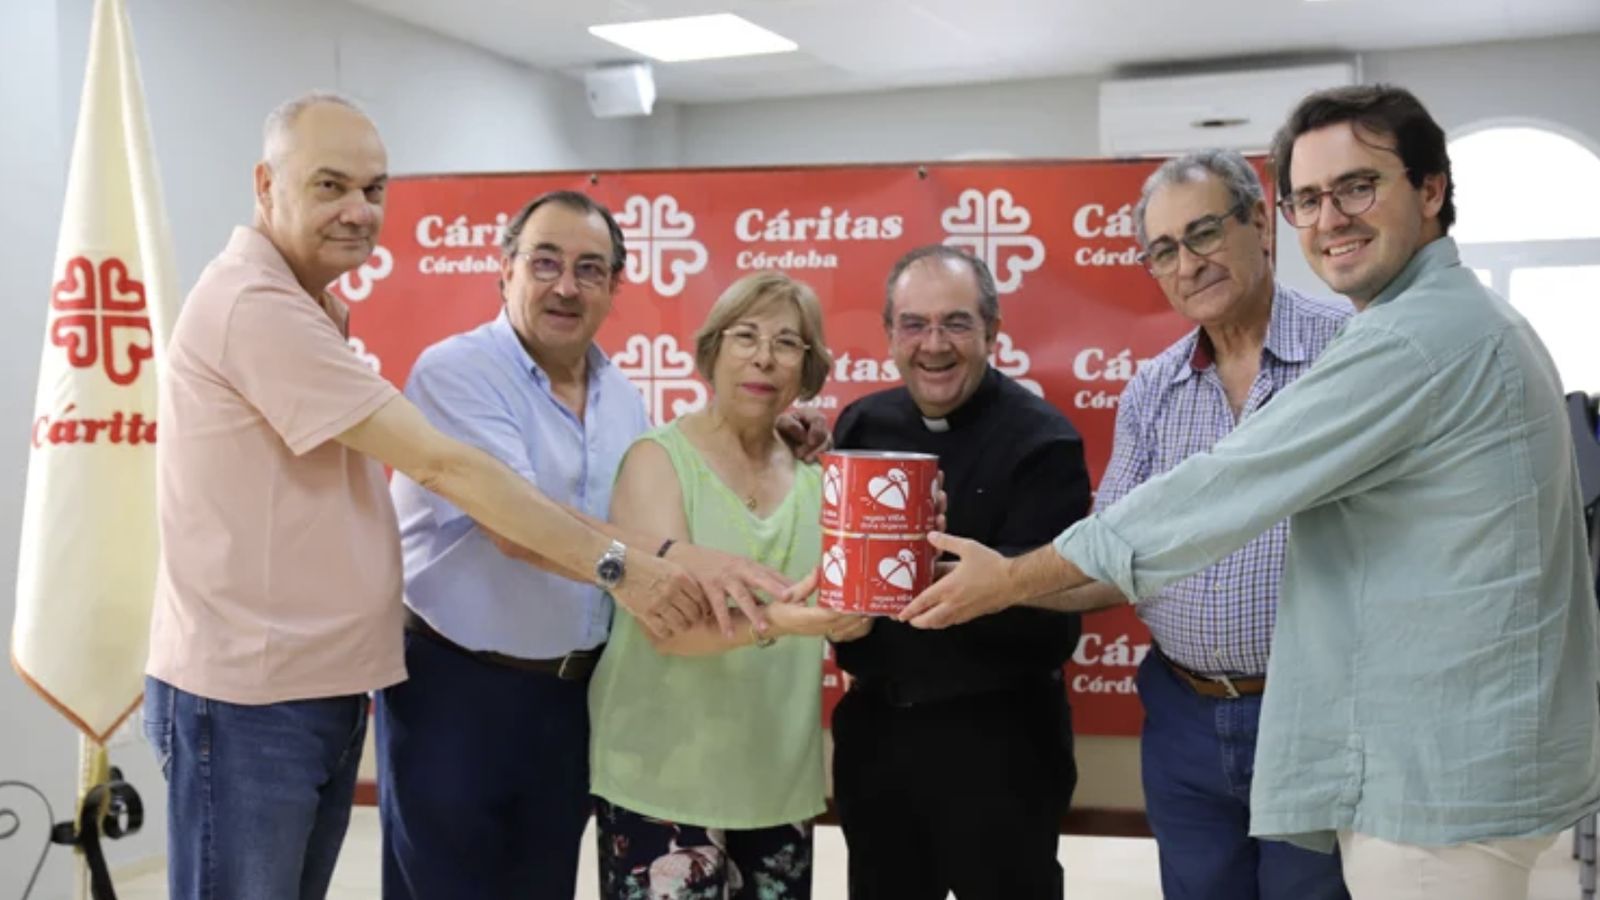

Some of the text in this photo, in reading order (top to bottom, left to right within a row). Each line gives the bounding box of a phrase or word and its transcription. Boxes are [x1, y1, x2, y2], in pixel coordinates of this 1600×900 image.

[416, 213, 508, 248] Cári
[735, 206, 903, 242] Cáritas
[418, 255, 500, 274] Córdob
[736, 250, 838, 269] Córdoba
[1072, 674, 1138, 693] Córd
